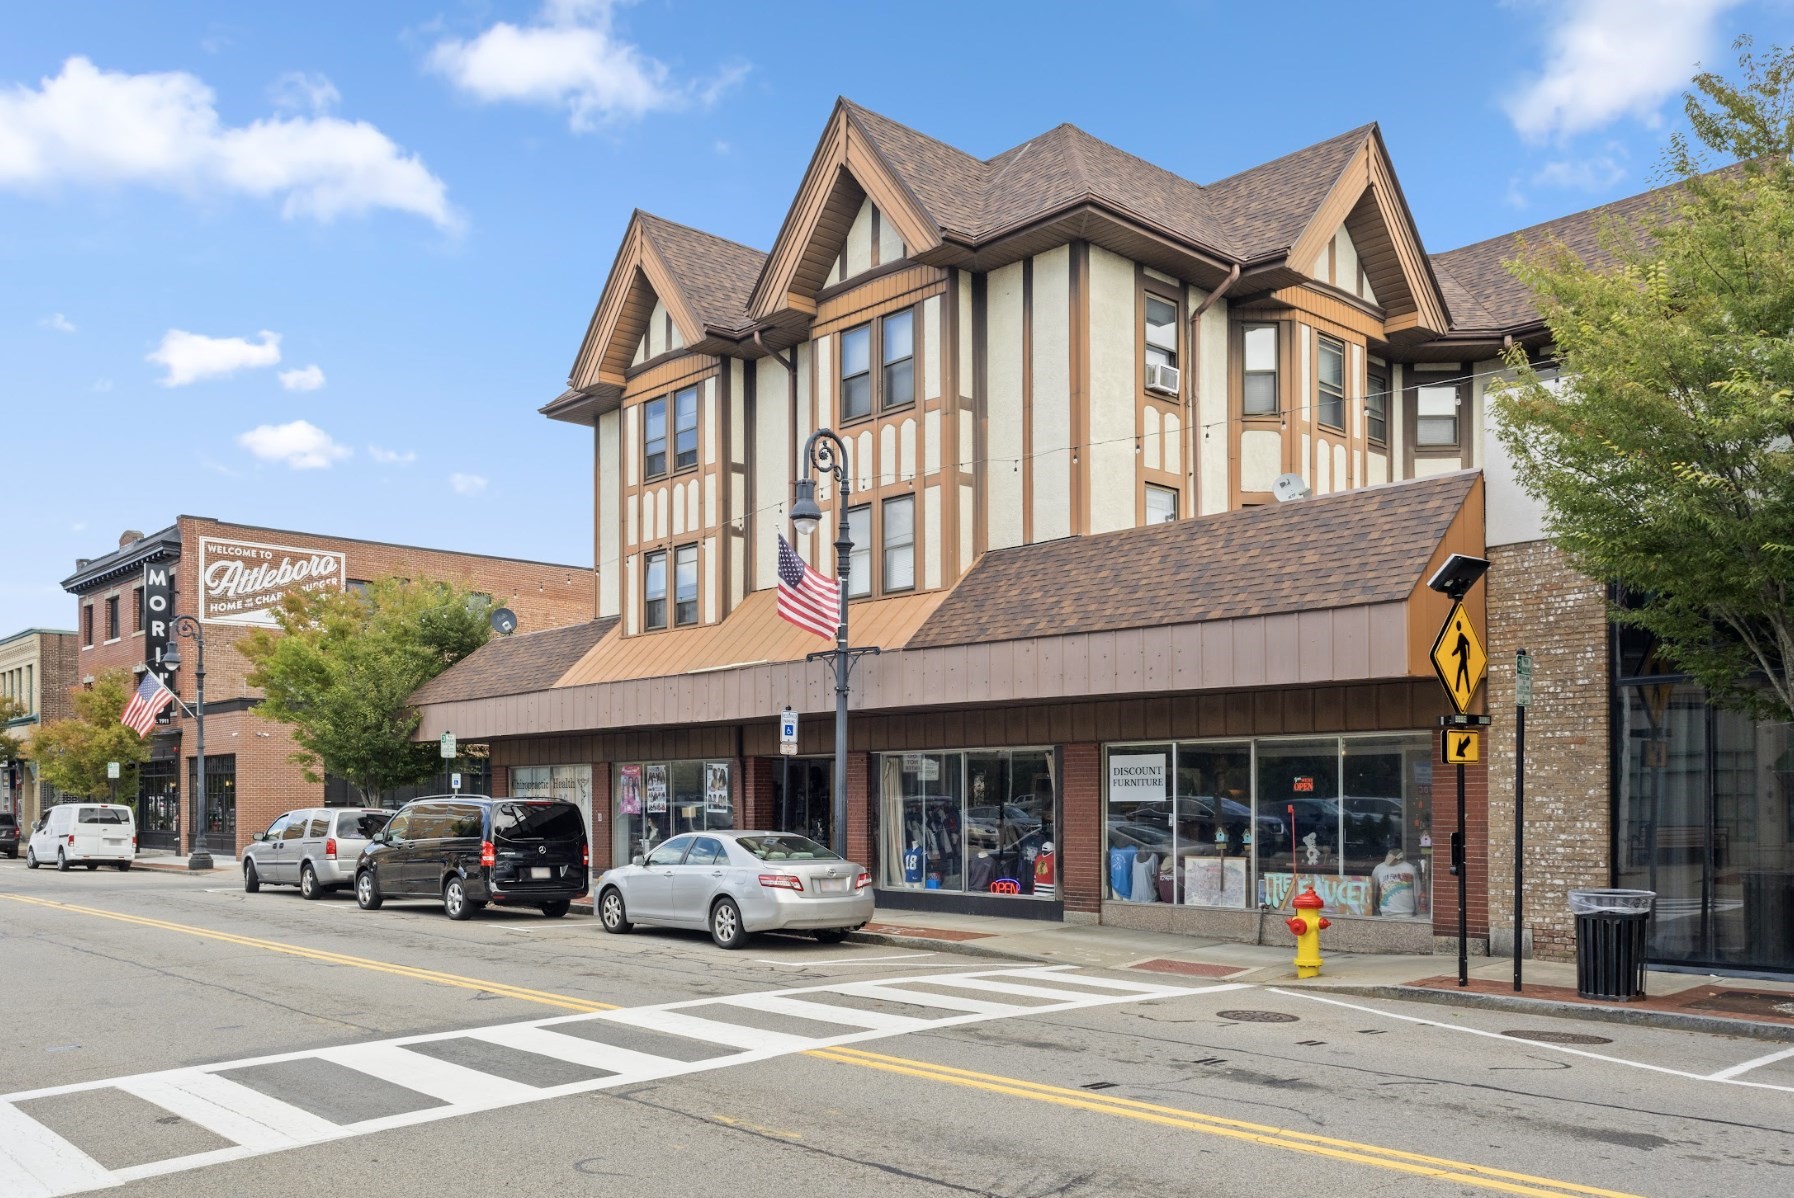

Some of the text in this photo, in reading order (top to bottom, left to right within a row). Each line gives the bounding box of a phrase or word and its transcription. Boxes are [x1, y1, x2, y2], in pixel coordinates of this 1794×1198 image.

[208, 545, 272, 560] WELCOME TO
[205, 555, 338, 597] Attleboro
[210, 600, 242, 612] HOME
[1113, 766, 1162, 776] DISCOUNT
[512, 778, 576, 791] Chiropractic Health
[1113, 778, 1163, 787] FURNITURE
[1294, 783, 1313, 791] OPEN
[905, 855, 917, 870] 18
[990, 881, 1018, 895] OPEN
